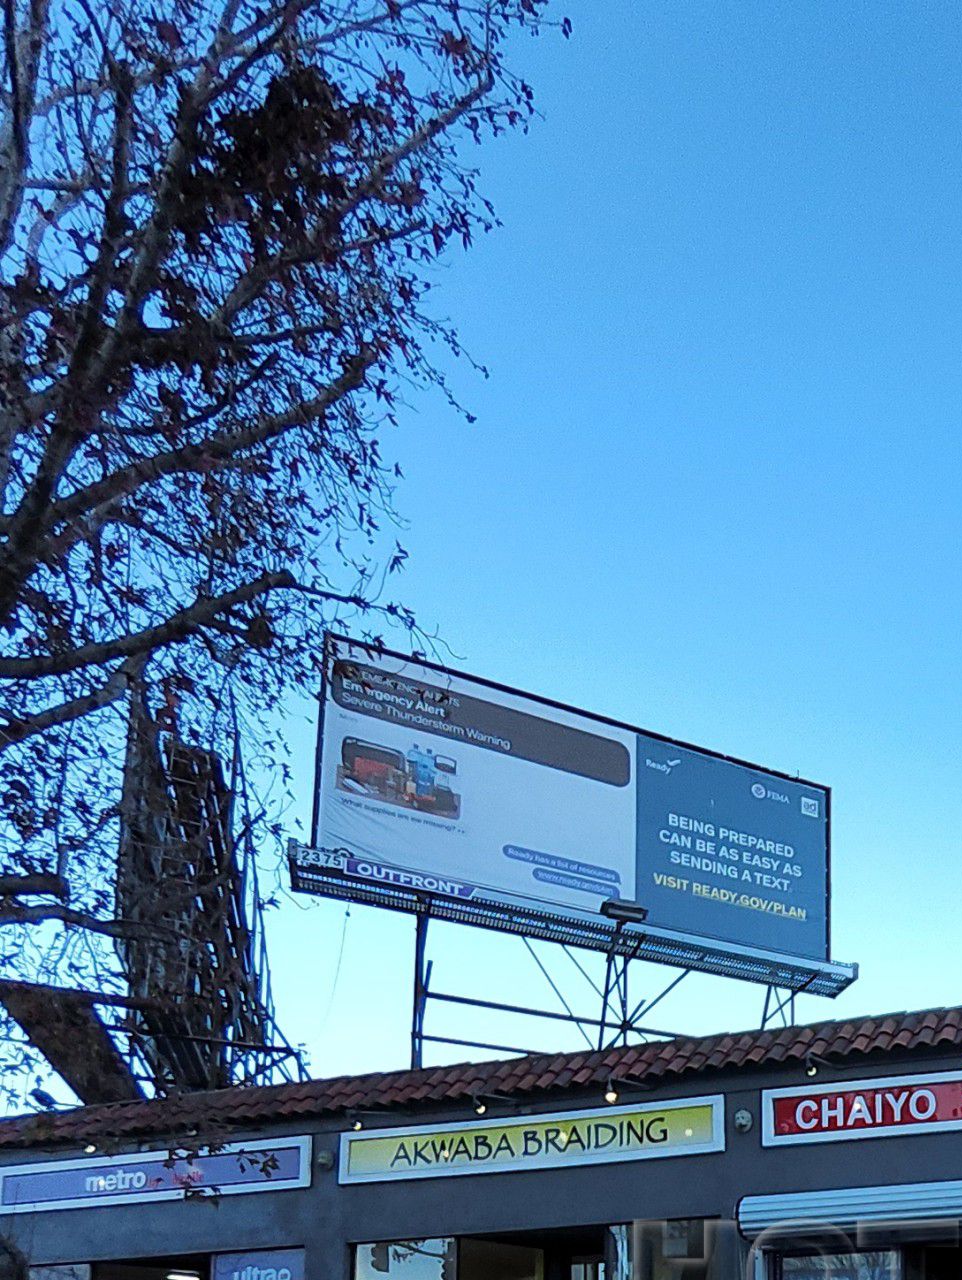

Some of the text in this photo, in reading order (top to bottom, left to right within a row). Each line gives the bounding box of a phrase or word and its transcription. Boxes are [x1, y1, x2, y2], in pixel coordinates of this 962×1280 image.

[342, 692, 383, 713] Severe
[385, 704, 465, 736] Thunderstorm
[466, 727, 512, 752] Warning
[414, 700, 446, 718] Alert
[767, 791, 790, 804] FEMA
[659, 829, 803, 878] CAN BE AS EASY AS
[668, 813, 795, 858] BEING PREPARED
[301, 850, 342, 867] 2375
[670, 850, 739, 878] SENDING
[741, 869, 753, 883] A
[356, 862, 465, 896] OUTFRONT
[653, 872, 807, 920] VISIT READY.GOV/PLAN
[795, 1088, 937, 1130] CHAIYO
[389, 1117, 669, 1168] AKWABA BRAIDING
[85, 1169, 147, 1192] metro
